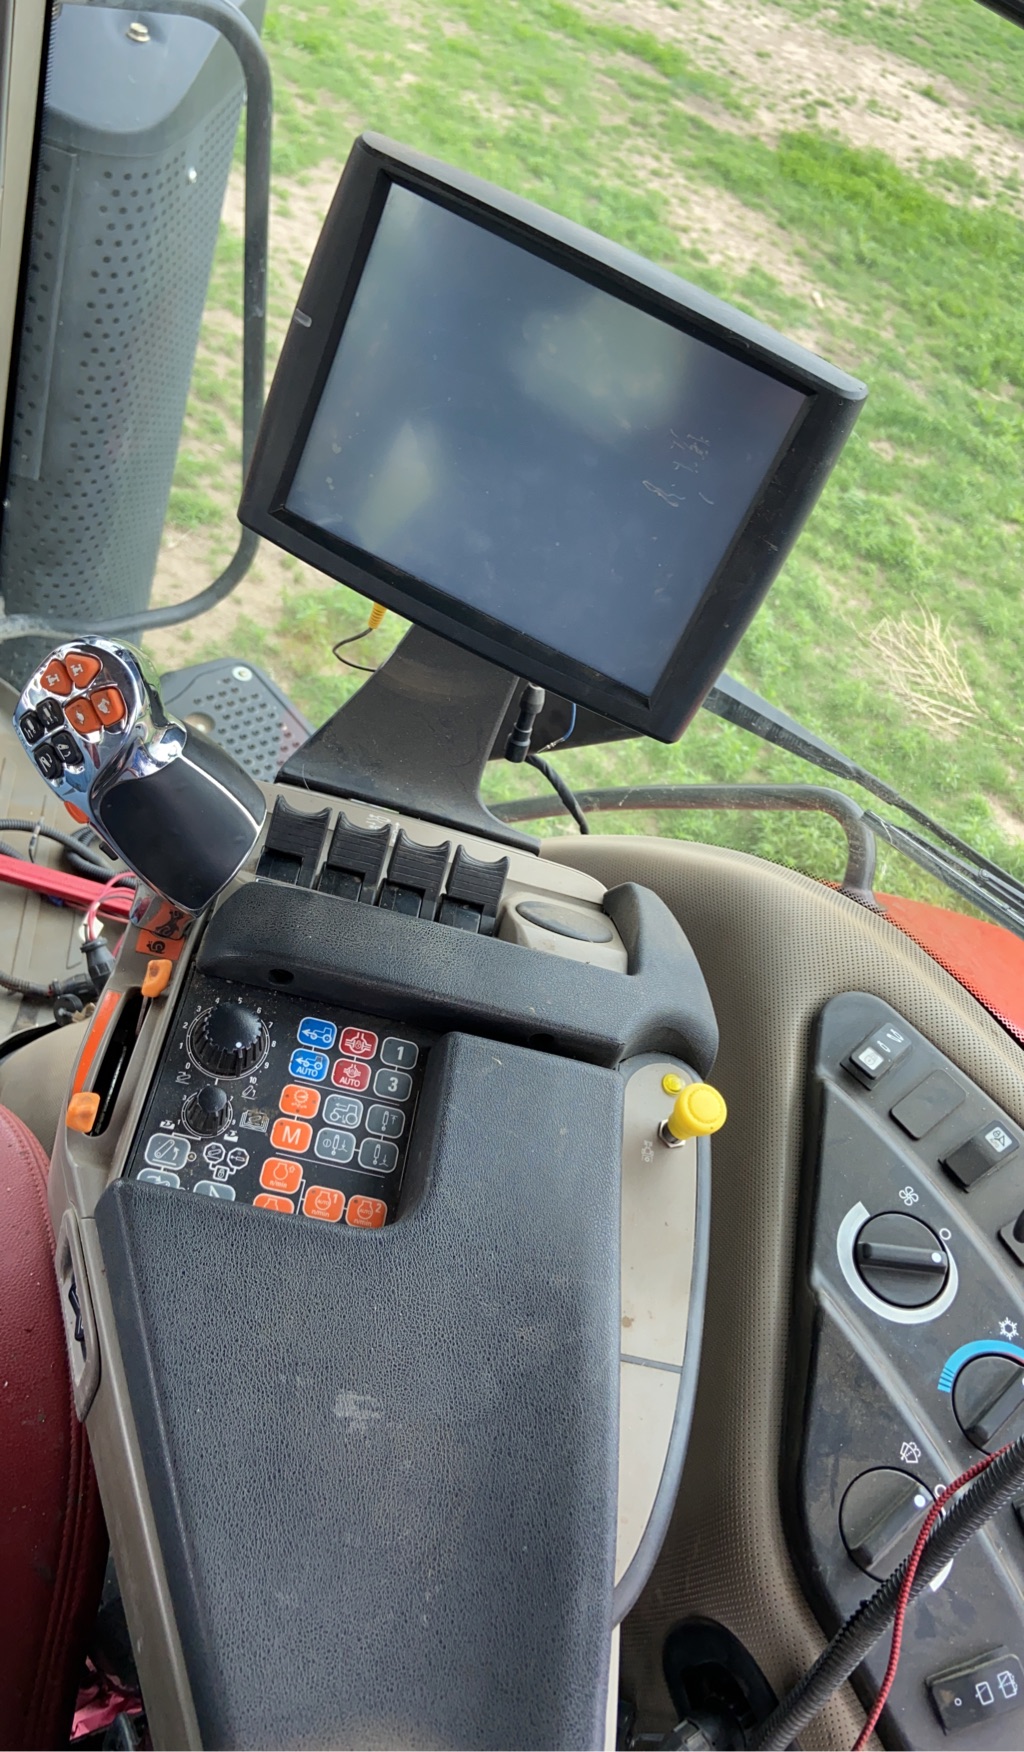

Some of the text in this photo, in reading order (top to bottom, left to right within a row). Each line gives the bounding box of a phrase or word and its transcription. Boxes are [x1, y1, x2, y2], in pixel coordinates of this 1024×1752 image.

[397, 1046, 404, 1060] 1
[297, 1067, 318, 1078] AUTO
[250, 1076, 257, 1084] 10
[339, 1077, 360, 1088] AUTO
[388, 1077, 398, 1092] 3
[282, 1125, 300, 1145] M
[332, 1194, 338, 1204] 1
[375, 1202, 382, 1213] 2
